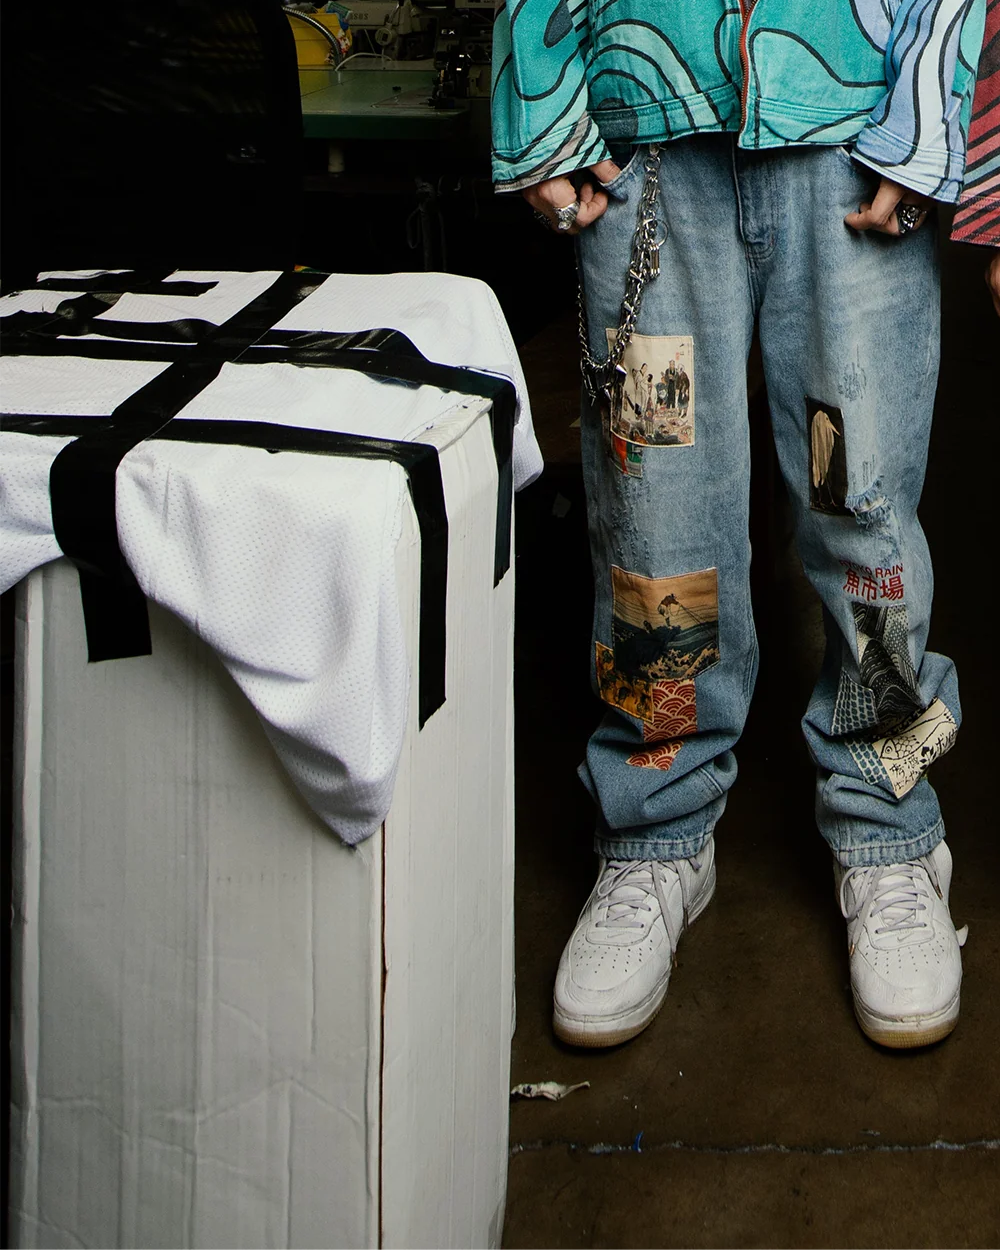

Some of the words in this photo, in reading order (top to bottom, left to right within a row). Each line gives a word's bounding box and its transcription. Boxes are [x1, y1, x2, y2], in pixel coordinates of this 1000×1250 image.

[839, 559, 873, 576] RYOKO
[875, 563, 904, 578] RAIN
[842, 567, 905, 601] 魚市場
